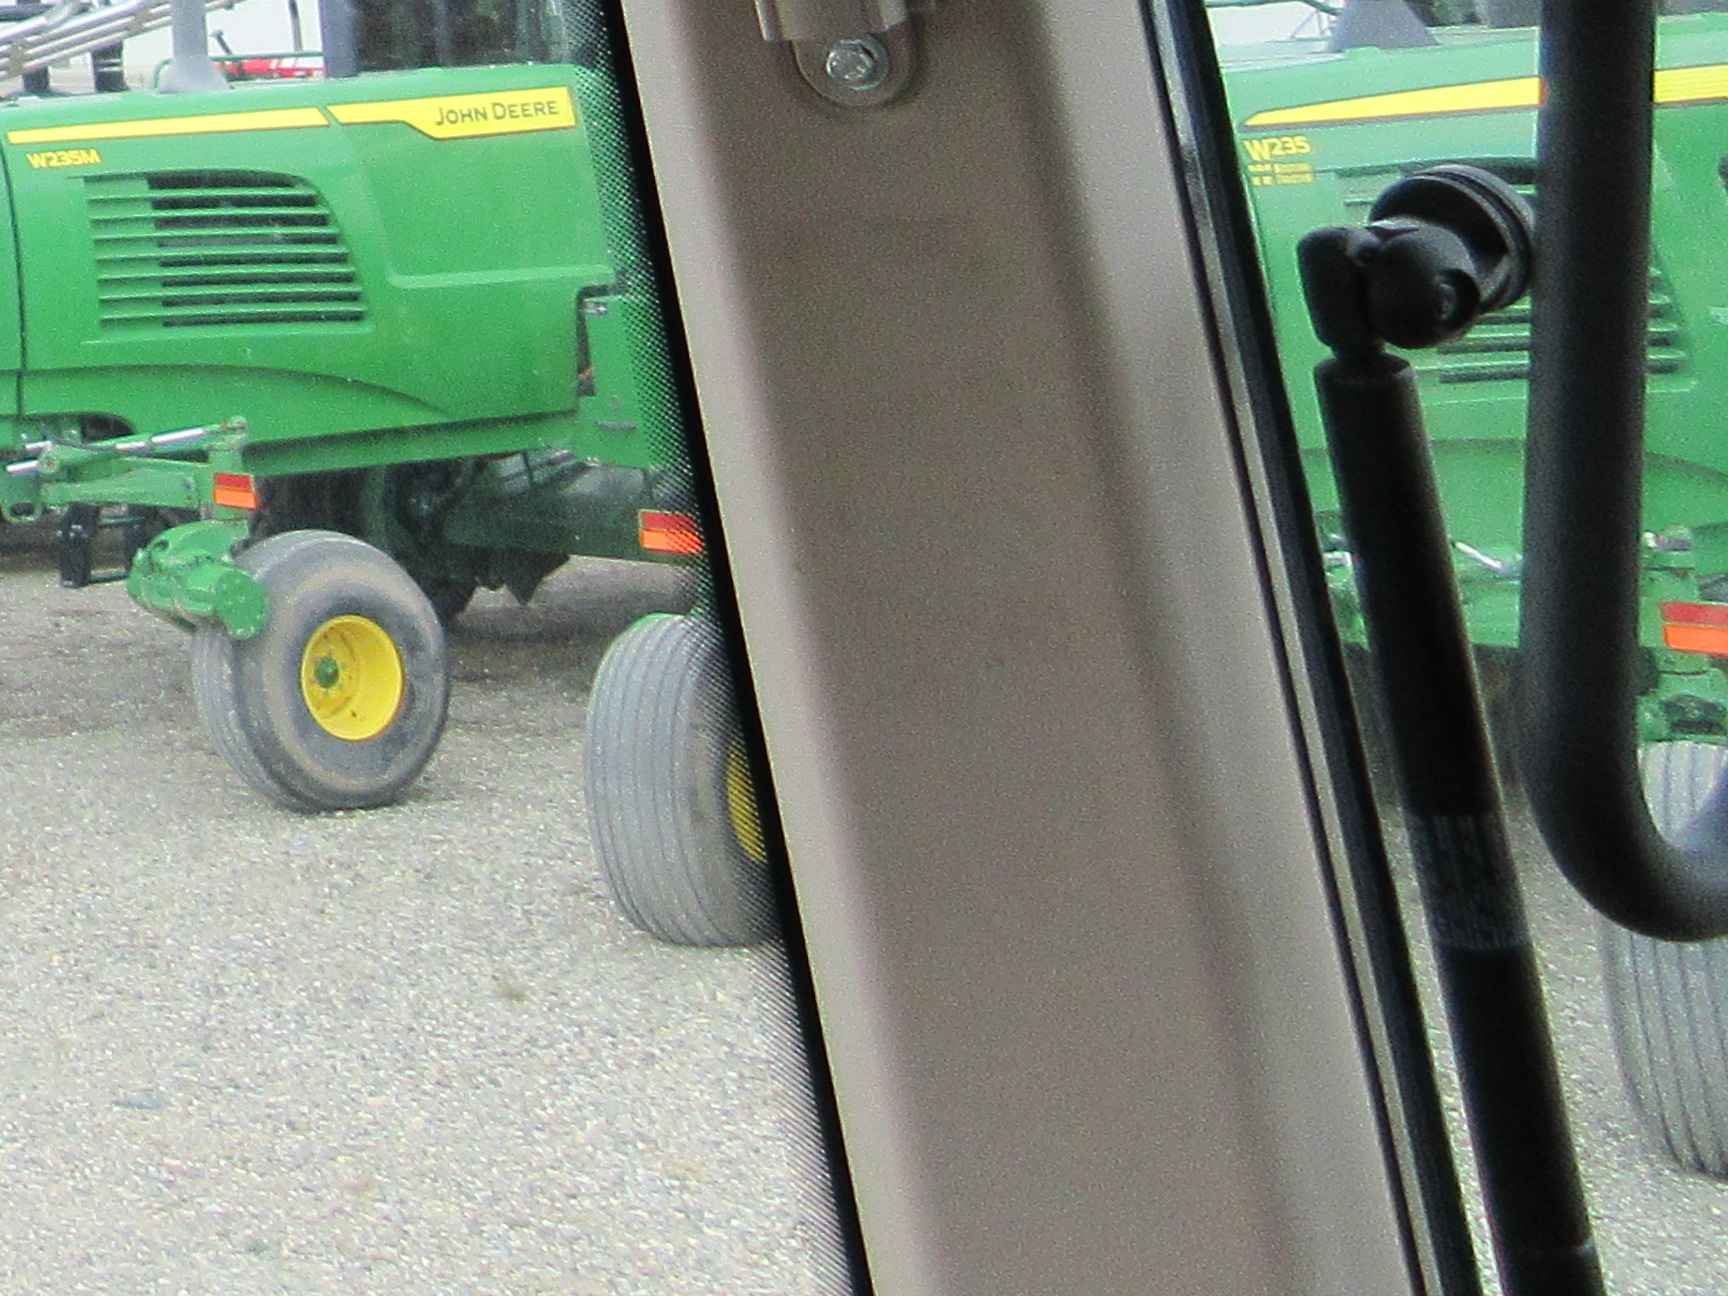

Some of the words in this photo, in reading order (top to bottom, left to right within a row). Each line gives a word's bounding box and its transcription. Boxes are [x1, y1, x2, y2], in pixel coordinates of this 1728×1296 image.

[435, 107, 488, 126] JOHN
[491, 100, 560, 120] DEERE
[25, 148, 102, 169] W235M
[1242, 135, 1312, 161] W235
